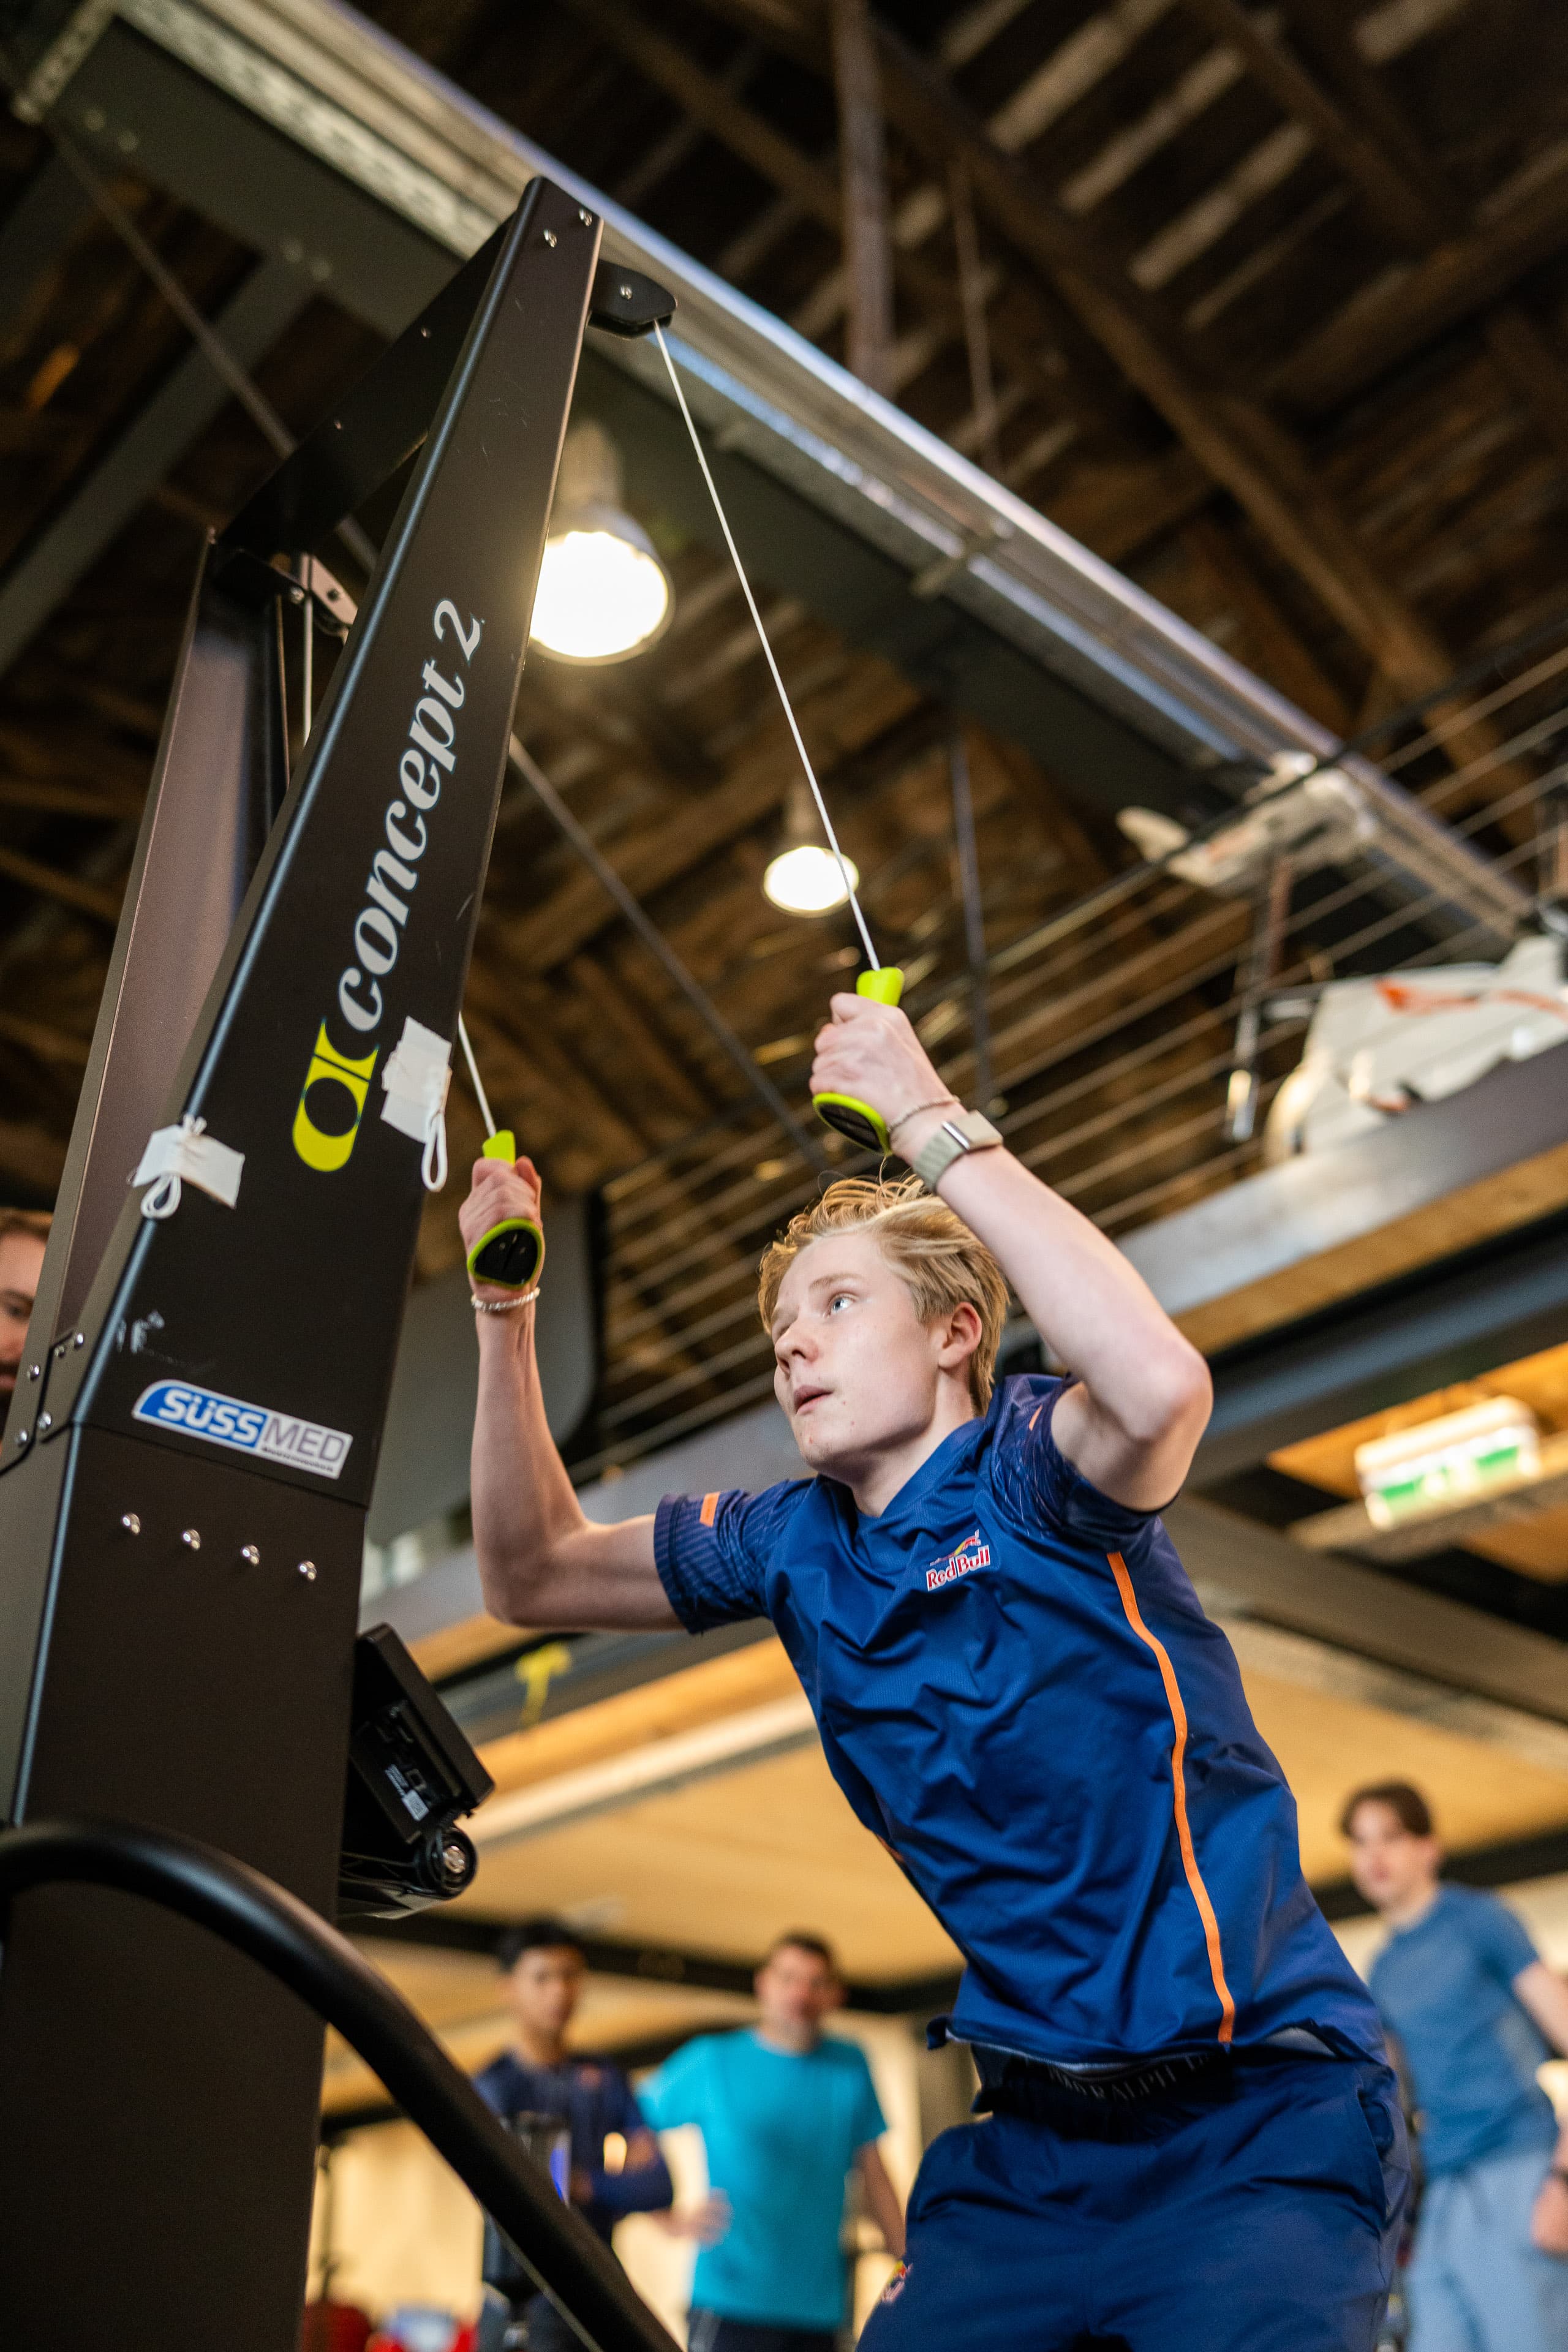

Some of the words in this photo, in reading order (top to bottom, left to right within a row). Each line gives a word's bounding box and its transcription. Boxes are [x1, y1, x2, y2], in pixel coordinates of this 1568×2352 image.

[339, 660, 465, 1031] concept
[434, 598, 481, 662] 2
[927, 1558, 956, 1591] Red
[956, 1546, 990, 1576] Bull
